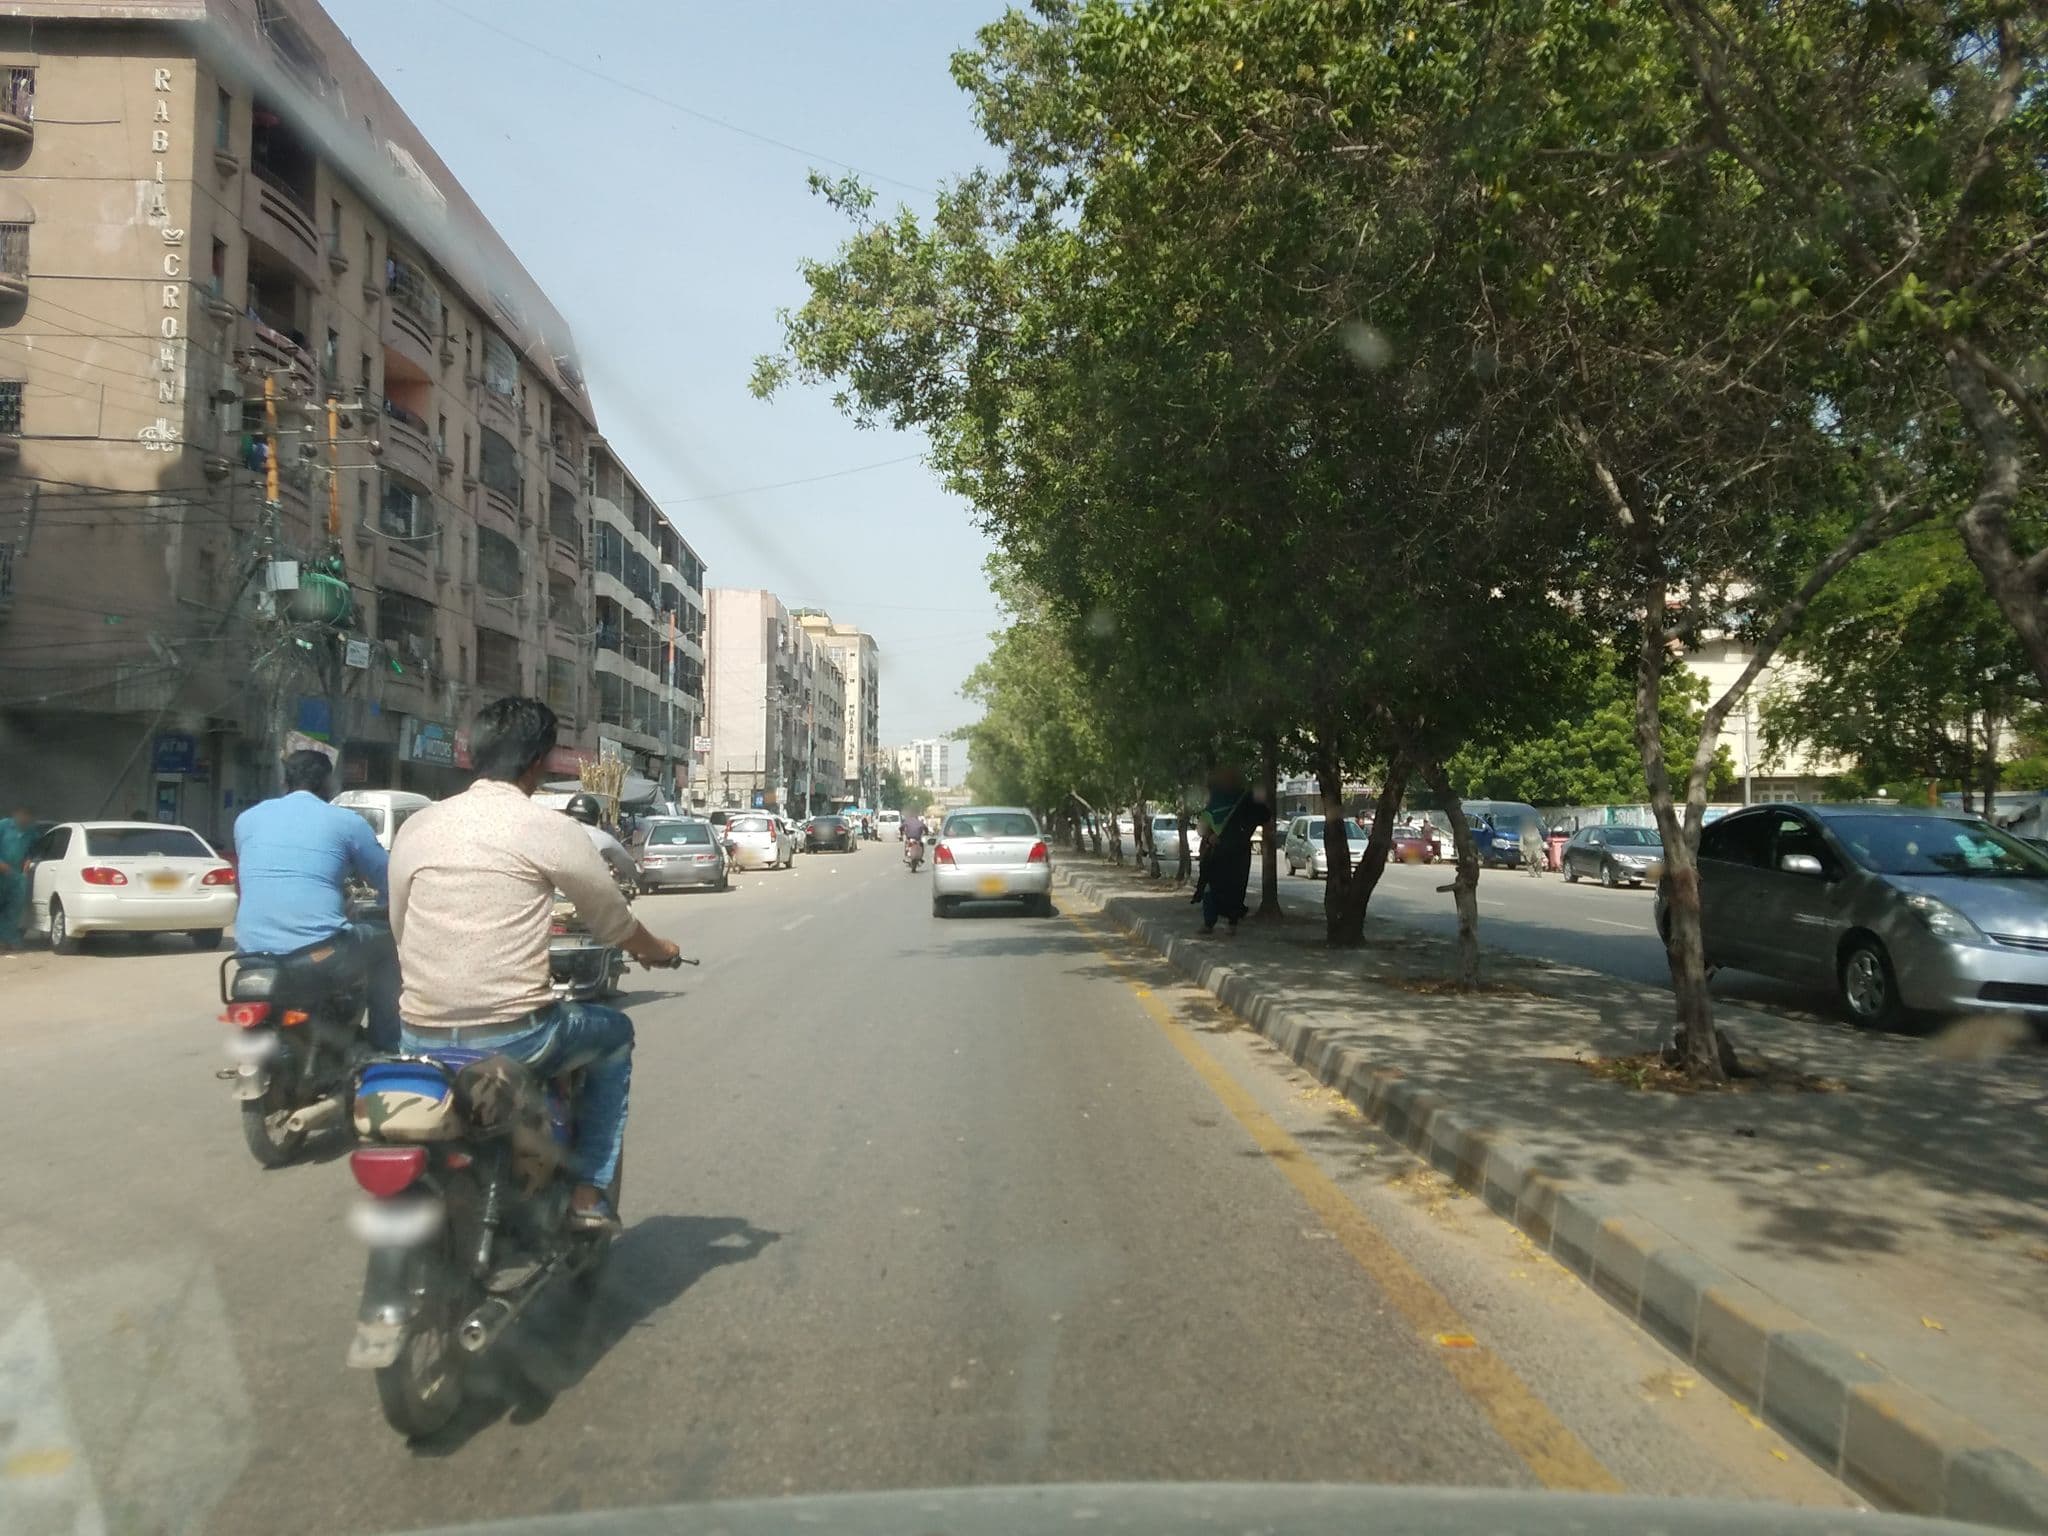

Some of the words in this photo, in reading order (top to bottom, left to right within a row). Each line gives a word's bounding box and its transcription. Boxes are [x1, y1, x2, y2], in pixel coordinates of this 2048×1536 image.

[151, 67, 171, 216] RABIA
[158, 252, 180, 404] CROWN
[158, 740, 188, 753] ATM
